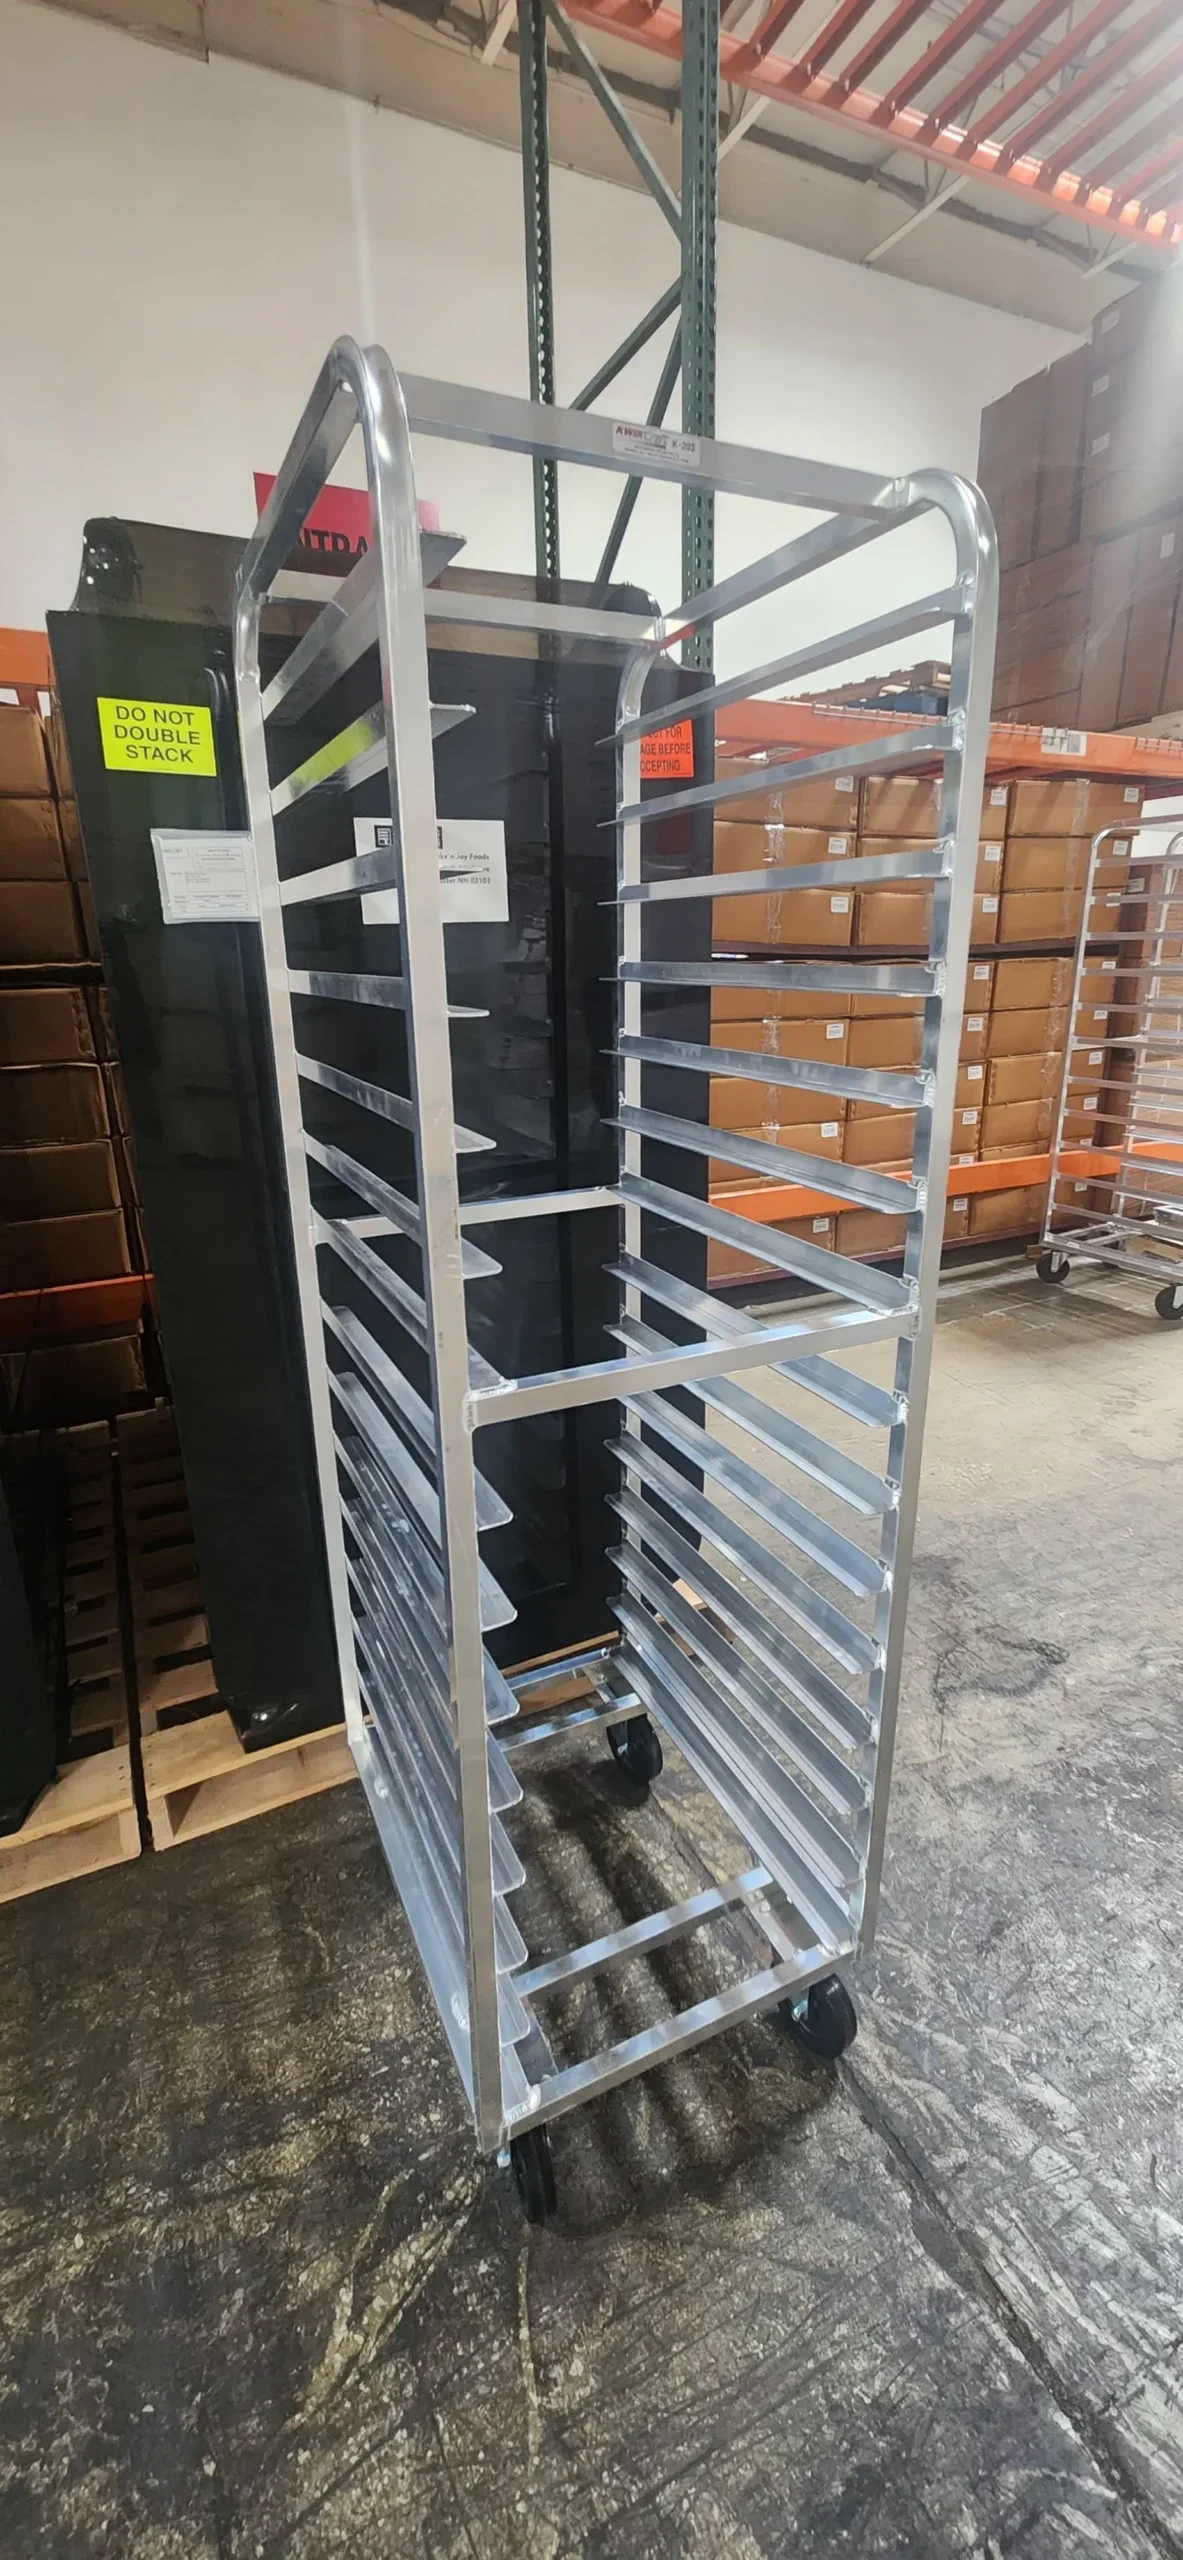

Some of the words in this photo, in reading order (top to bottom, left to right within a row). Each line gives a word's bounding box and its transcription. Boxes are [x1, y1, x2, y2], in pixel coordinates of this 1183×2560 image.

[115, 705, 146, 722] DO
[153, 708, 194, 726] NOT
[114, 724, 201, 746] DOUBLE
[125, 744, 194, 764] STACK
[640, 743, 657, 756] AGE
[658, 743, 692, 756] BEFORE
[640, 759, 681, 773] CCEPTING
[456, 853, 468, 861] Joy
[469, 852, 489, 860] Foods
